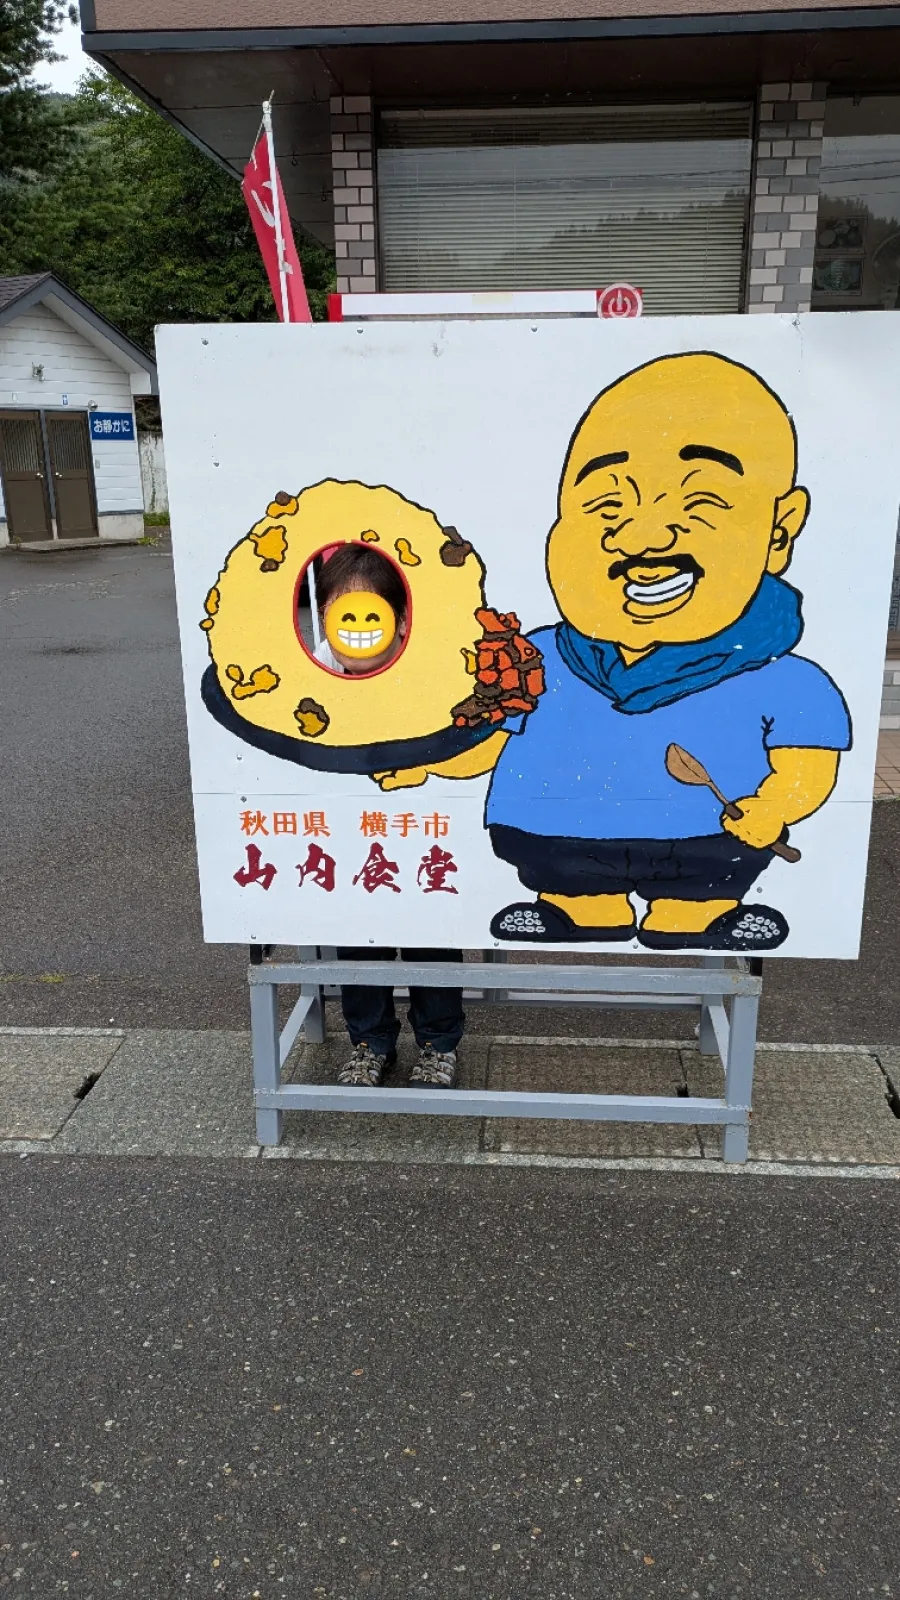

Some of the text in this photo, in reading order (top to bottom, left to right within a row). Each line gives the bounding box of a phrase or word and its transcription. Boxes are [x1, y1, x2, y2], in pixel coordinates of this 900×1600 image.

[93, 419, 131, 434] お静かに
[239, 810, 451, 838] 秋田県 横手市
[233, 842, 459, 894] 山内食堂
